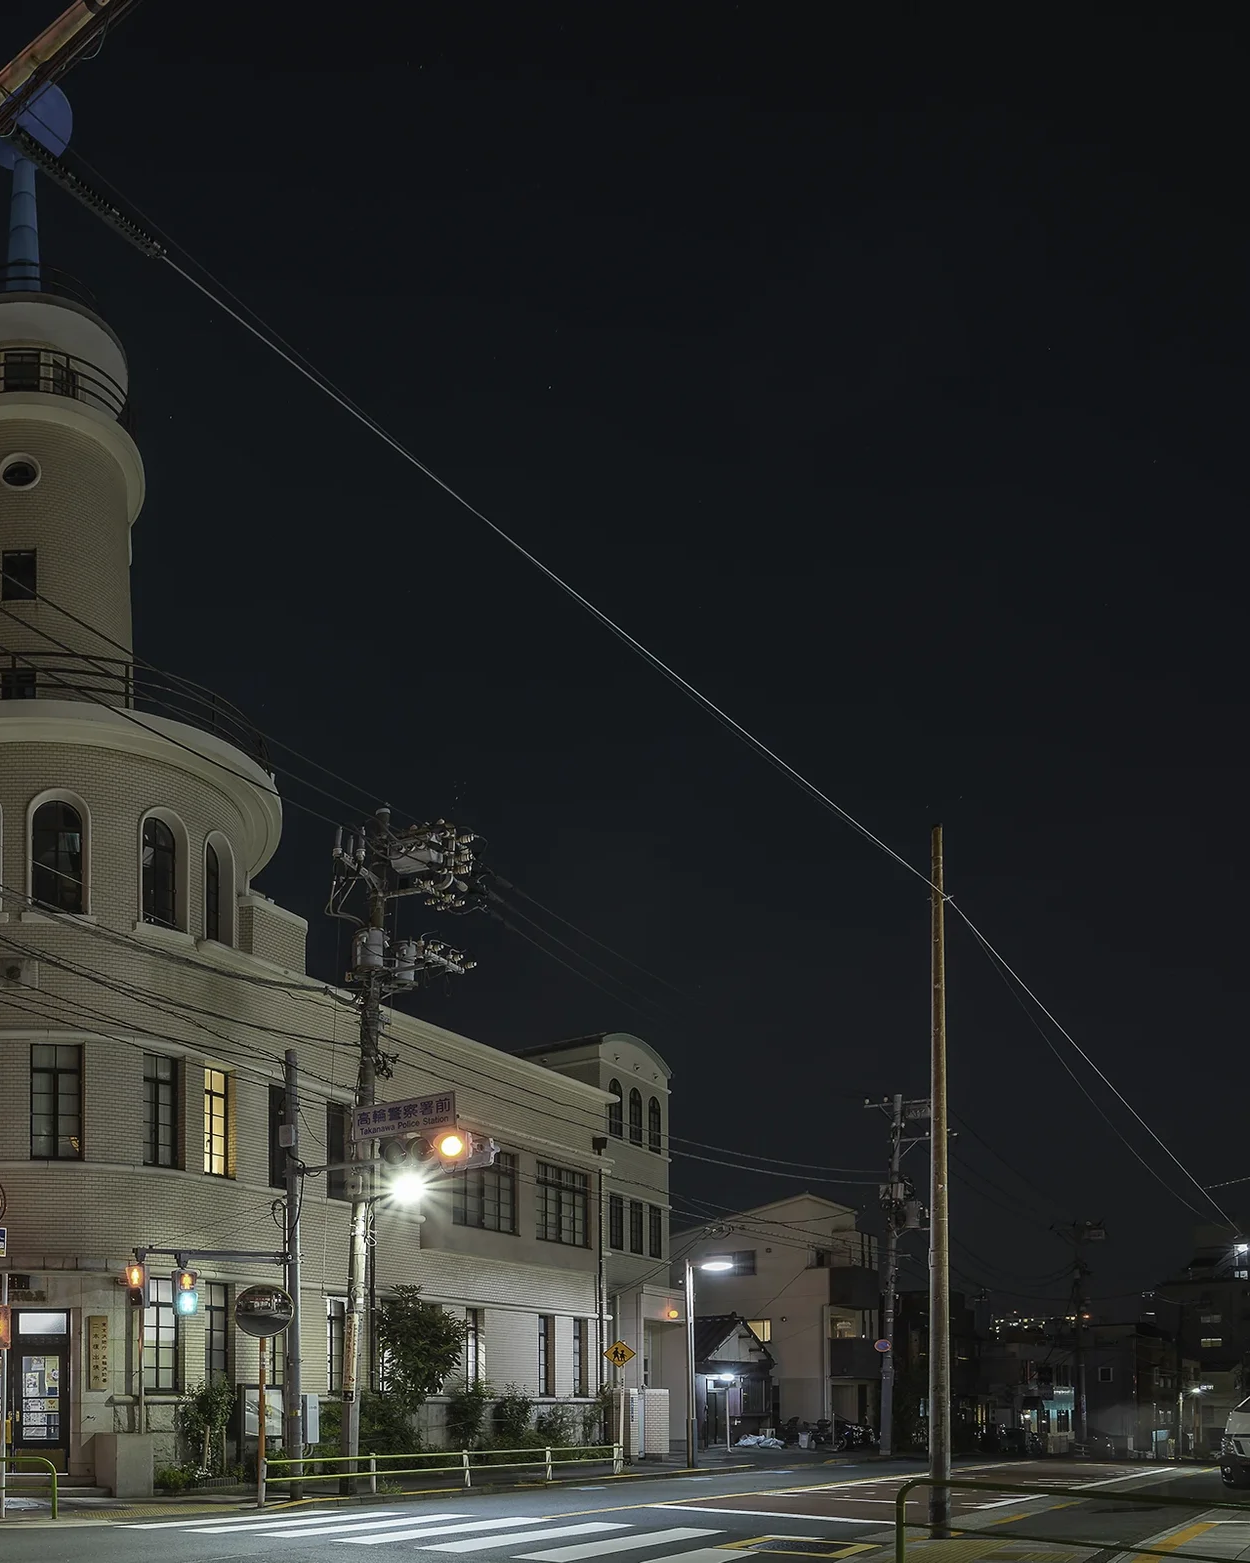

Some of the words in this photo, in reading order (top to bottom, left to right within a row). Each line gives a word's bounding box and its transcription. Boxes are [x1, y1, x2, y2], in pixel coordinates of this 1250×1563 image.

[357, 1098, 451, 1127] 高輪警察署前
[360, 1124, 395, 1136] Takanawa
[397, 1120, 420, 1130] Police
[423, 1115, 449, 1126] Station
